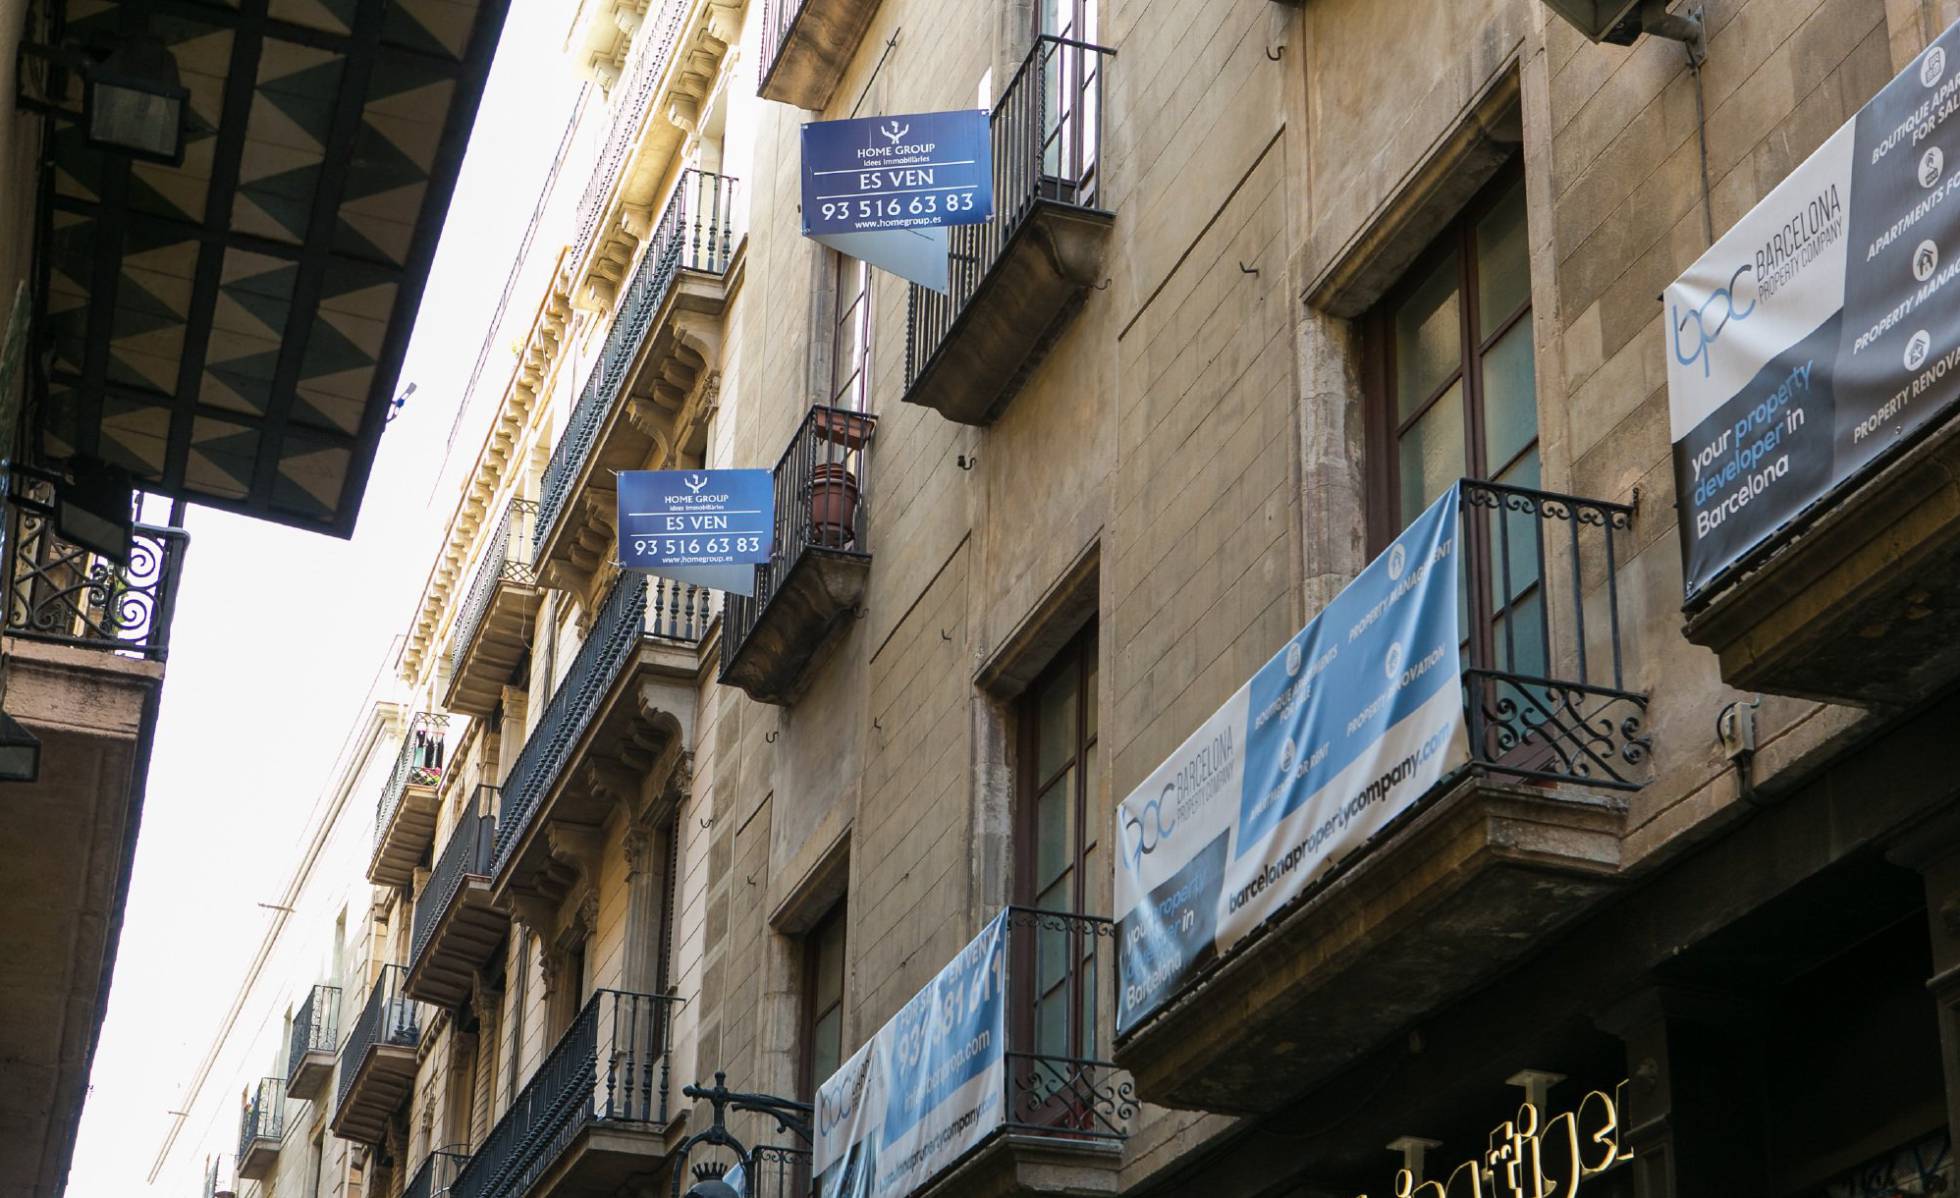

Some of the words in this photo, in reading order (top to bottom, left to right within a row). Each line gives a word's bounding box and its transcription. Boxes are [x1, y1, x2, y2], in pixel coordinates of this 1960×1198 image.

[857, 146, 892, 159] HOME
[895, 143, 935, 155] GROUP
[1871, 100, 1930, 165] BOUTIQUE
[1912, 115, 1936, 146] FOR
[821, 202, 849, 221] 93
[859, 198, 901, 218] 516
[909, 195, 937, 214] 63
[945, 192, 973, 212] 83
[860, 173, 882, 190] ES
[889, 169, 934, 187] VEN
[854, 215, 942, 229] www.homegroup.es
[1756, 183, 1841, 282] BARCELONA
[1866, 185, 1944, 262] APARTMENTS
[1758, 256, 1800, 305] PROPERTY
[1802, 215, 1843, 268] COMPANY
[1853, 296, 1914, 355] PROPERTY
[1691, 428, 1731, 481] your
[1734, 360, 1813, 448] property
[1854, 386, 1910, 444] PROPERTY
[1694, 421, 1784, 507] developer
[1786, 406, 1805, 435] in
[664, 495, 693, 504] HOME
[695, 494, 729, 503] GROUP
[666, 516, 684, 531] ES
[690, 515, 728, 530] VEN
[1696, 453, 1790, 539] Barcelona
[634, 539, 658, 556] 93
[665, 538, 700, 555] 516
[706, 537, 729, 554] 63
[736, 537, 760, 553] 83
[1176, 725, 1234, 804] BARCELONA
[1182, 908, 1194, 932] in
